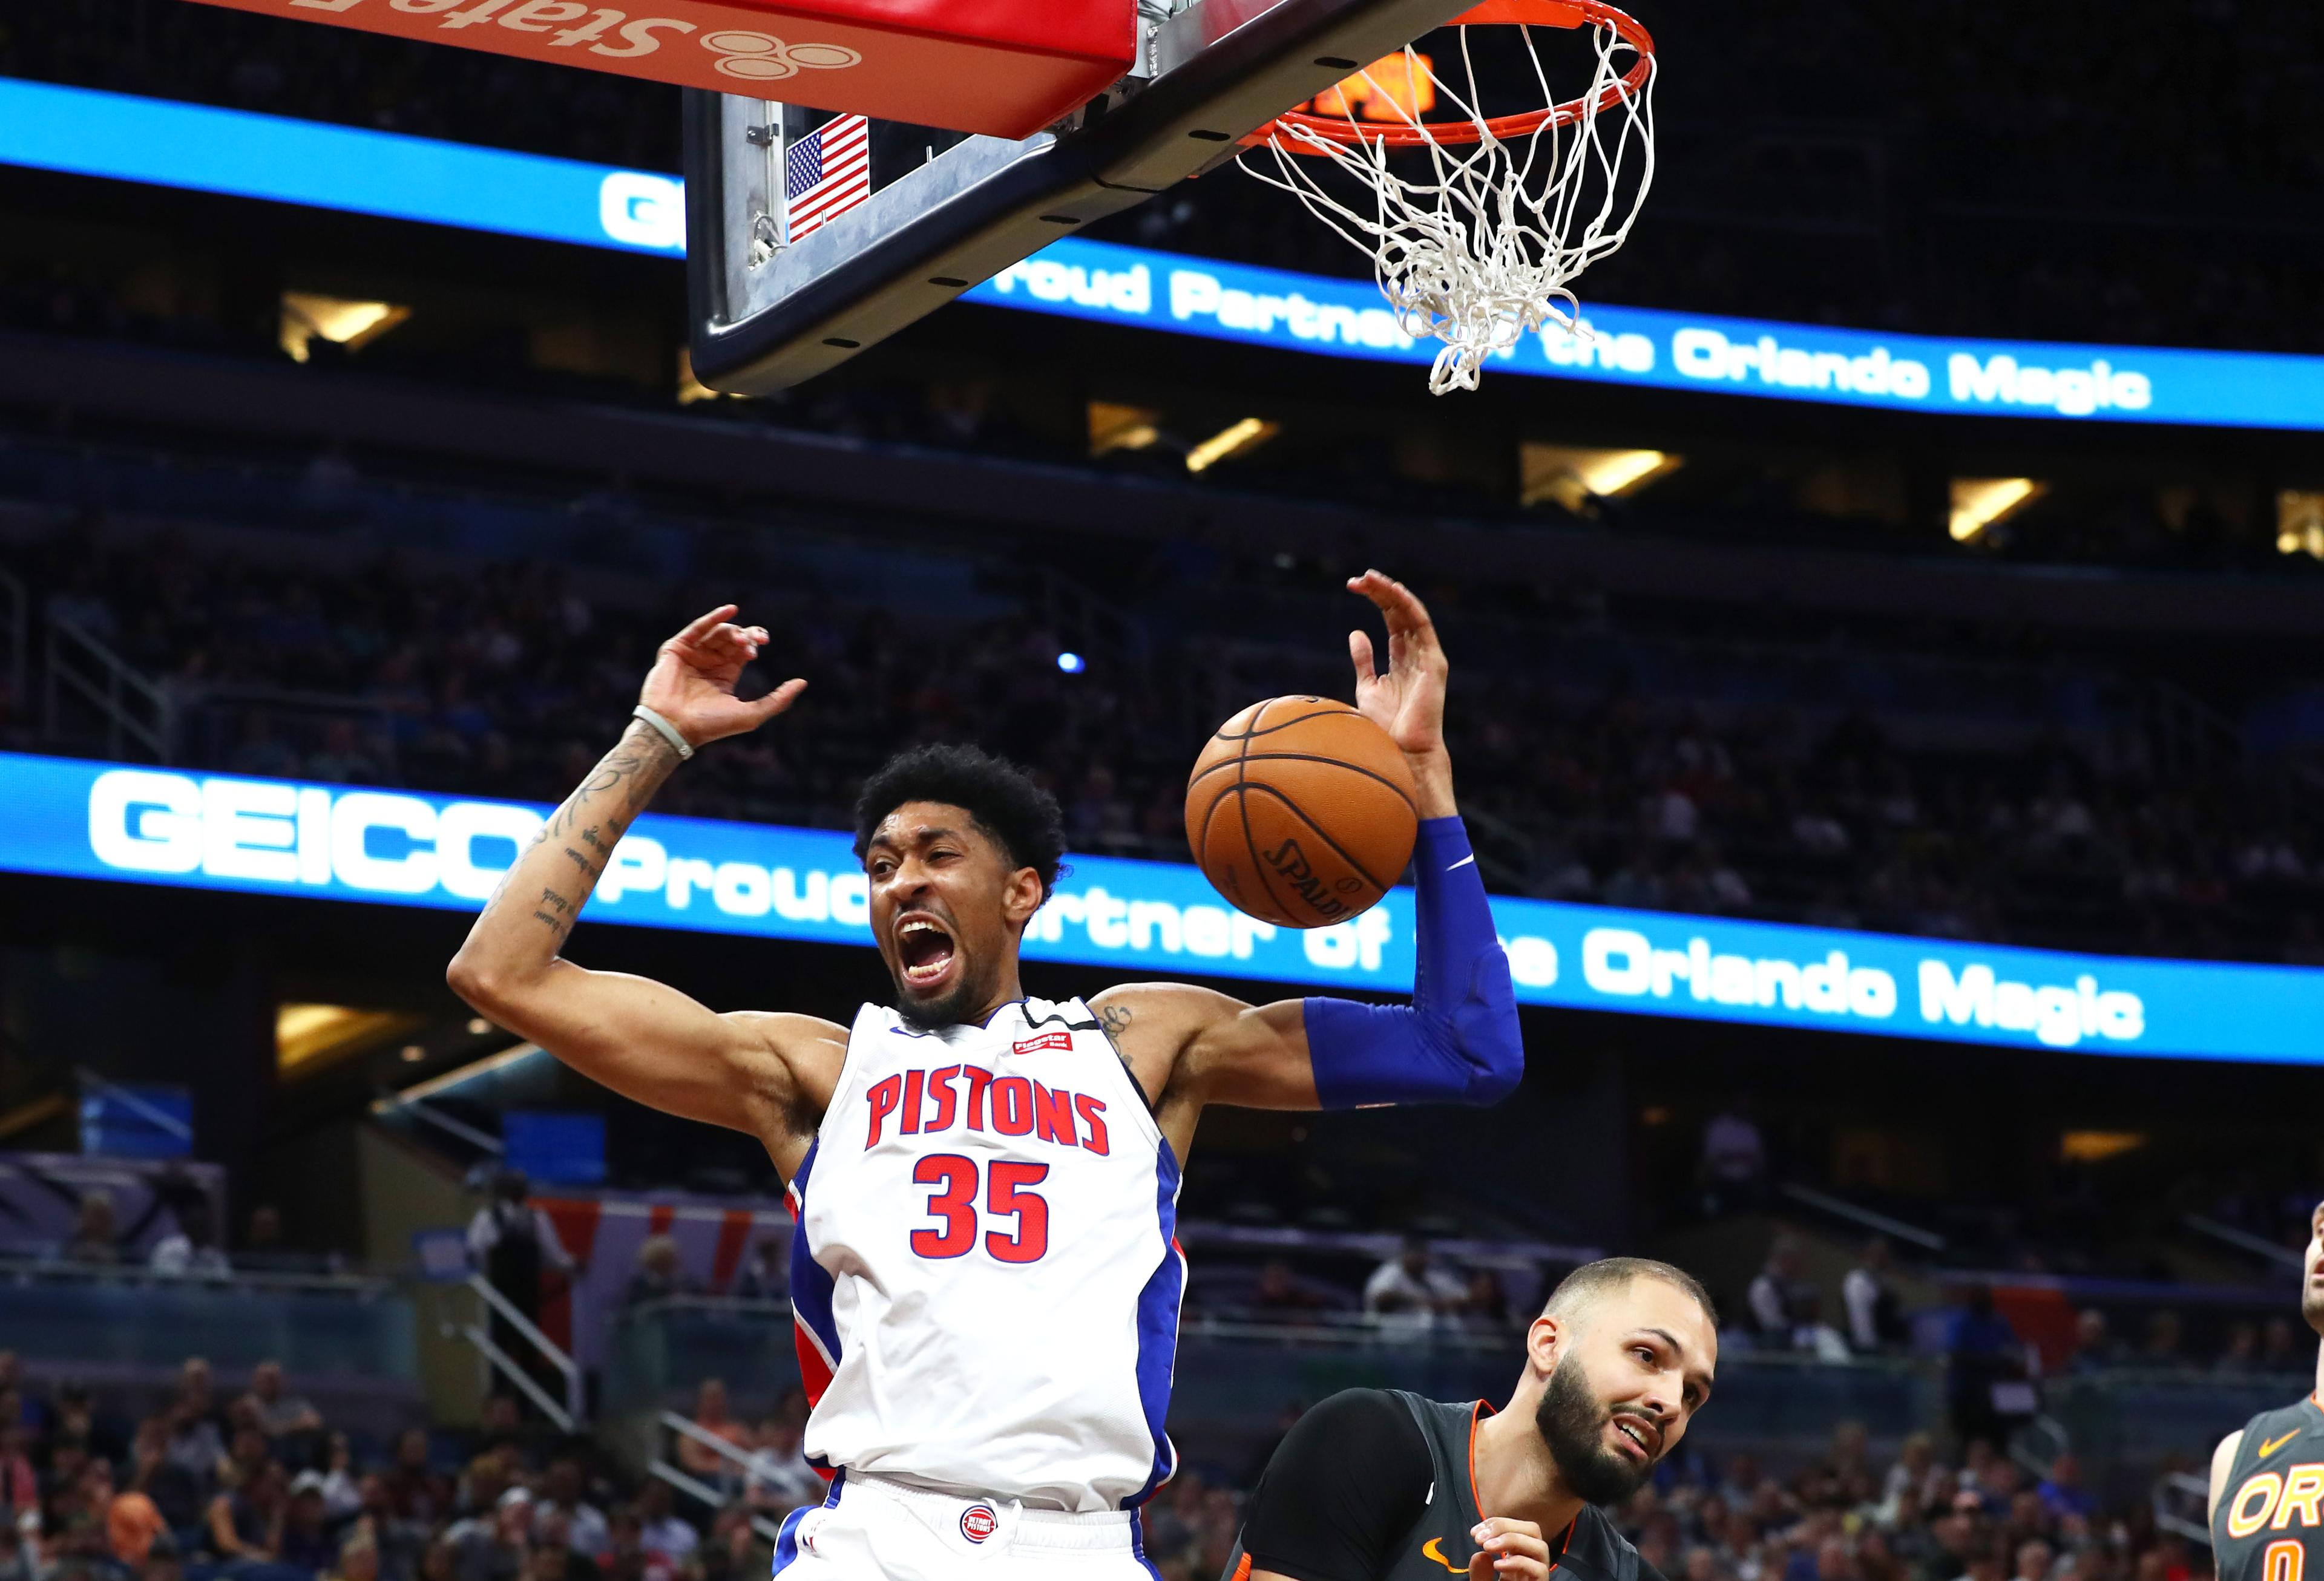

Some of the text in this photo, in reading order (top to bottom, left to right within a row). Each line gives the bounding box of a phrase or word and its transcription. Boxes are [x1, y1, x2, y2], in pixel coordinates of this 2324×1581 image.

[991, 259, 1151, 314] roud
[1170, 270, 1423, 350] Partner
[1539, 318, 1655, 373] the
[1672, 328, 1930, 398] Orlando
[1948, 353, 2152, 416] Magic
[88, 770, 547, 900] GEICO
[1022, 886, 1276, 959] rtner
[1303, 906, 1391, 971] of
[1583, 928, 1897, 1018] Orlando
[1918, 960, 2144, 1046] Magic
[1263, 838, 1356, 923] SPALDI
[1015, 1034, 1066, 1050] Flagstar
[865, 1064, 1109, 1157] PISTONS
[910, 1154, 1049, 1263] 35
[967, 1523, 991, 1533] PISTONS
[969, 1516, 991, 1526] DETROIT
[2228, 1462, 2324, 1539] OR
